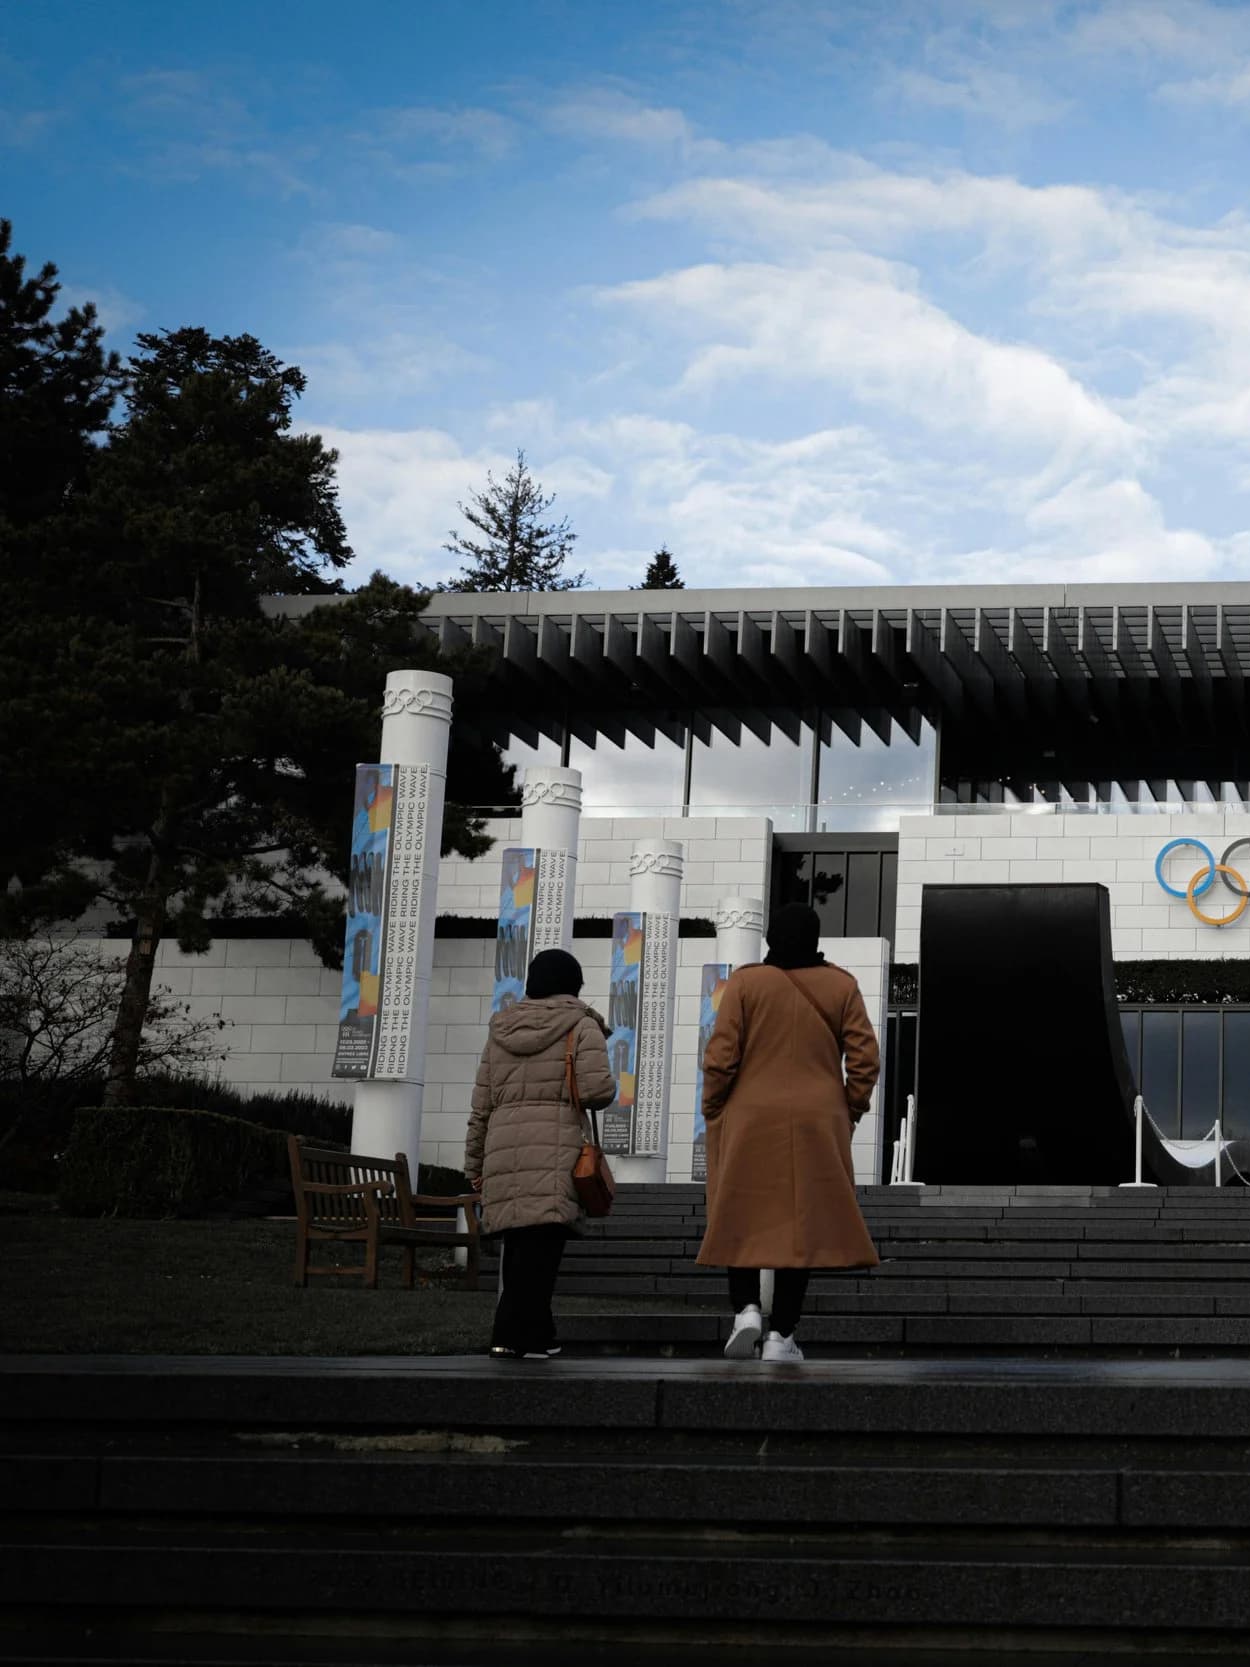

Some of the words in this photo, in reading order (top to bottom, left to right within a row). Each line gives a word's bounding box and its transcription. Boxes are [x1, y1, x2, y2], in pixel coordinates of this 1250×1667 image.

[399, 767, 407, 798] WAVE
[409, 767, 418, 798] WAVE
[395, 802, 405, 850] OLYMPIC
[405, 802, 415, 850] OLYMPIC
[415, 802, 426, 850] OLYMPIC
[393, 854, 401, 876] THE
[403, 854, 411, 876] THE
[413, 854, 421, 876] THE
[549, 850, 557, 879] WAVE
[390, 879, 399, 917] RIDING
[400, 879, 409, 917] RIDING
[410, 879, 419, 917] RIDING
[536, 881, 546, 924] OLYMPIC
[545, 881, 555, 924] OLYMPIC
[554, 881, 564, 924] OLYMPIC
[388, 921, 396, 953] WAVE
[398, 921, 406, 953] WAVE
[407, 921, 416, 953] WAVE
[384, 956, 394, 1006] OLYMPIC
[394, 956, 404, 1006] OLYMPIC
[403, 956, 414, 1006] OLYMPIC
[391, 1009, 400, 1032] THE
[401, 1009, 409, 1032] THE
[377, 1035, 387, 1073] RIDING
[388, 1035, 397, 1073] RIDING
[398, 1035, 407, 1073] RIDING
